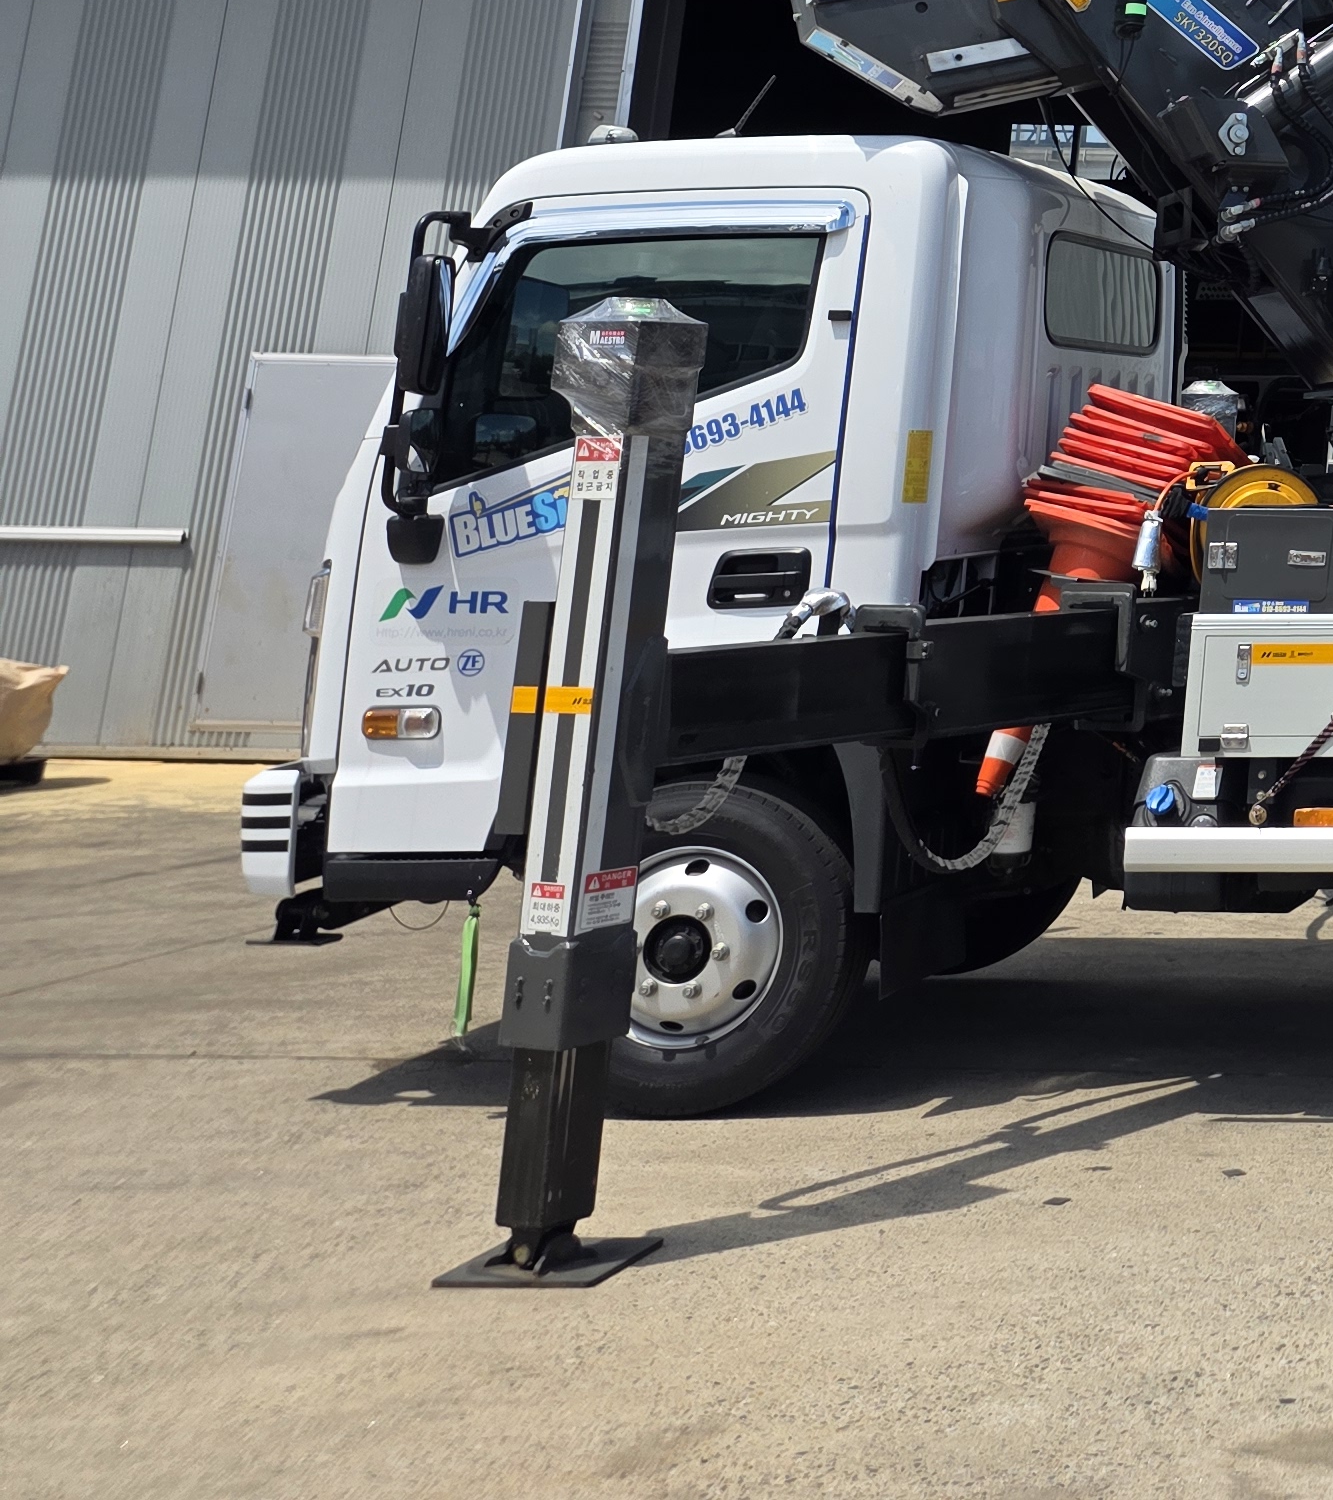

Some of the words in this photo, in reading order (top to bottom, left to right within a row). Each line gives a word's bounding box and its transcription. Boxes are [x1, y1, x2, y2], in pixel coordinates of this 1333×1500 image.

[590, 330, 625, 345] MAESTRO
[684, 387, 807, 455] 693-4144
[720, 508, 819, 526] MIGHTY
[448, 591, 509, 614] HR
[372, 657, 451, 673] AUTO
[459, 652, 484, 674] ZF
[376, 683, 435, 698] EX10
[601, 870, 632, 881] DANGER
